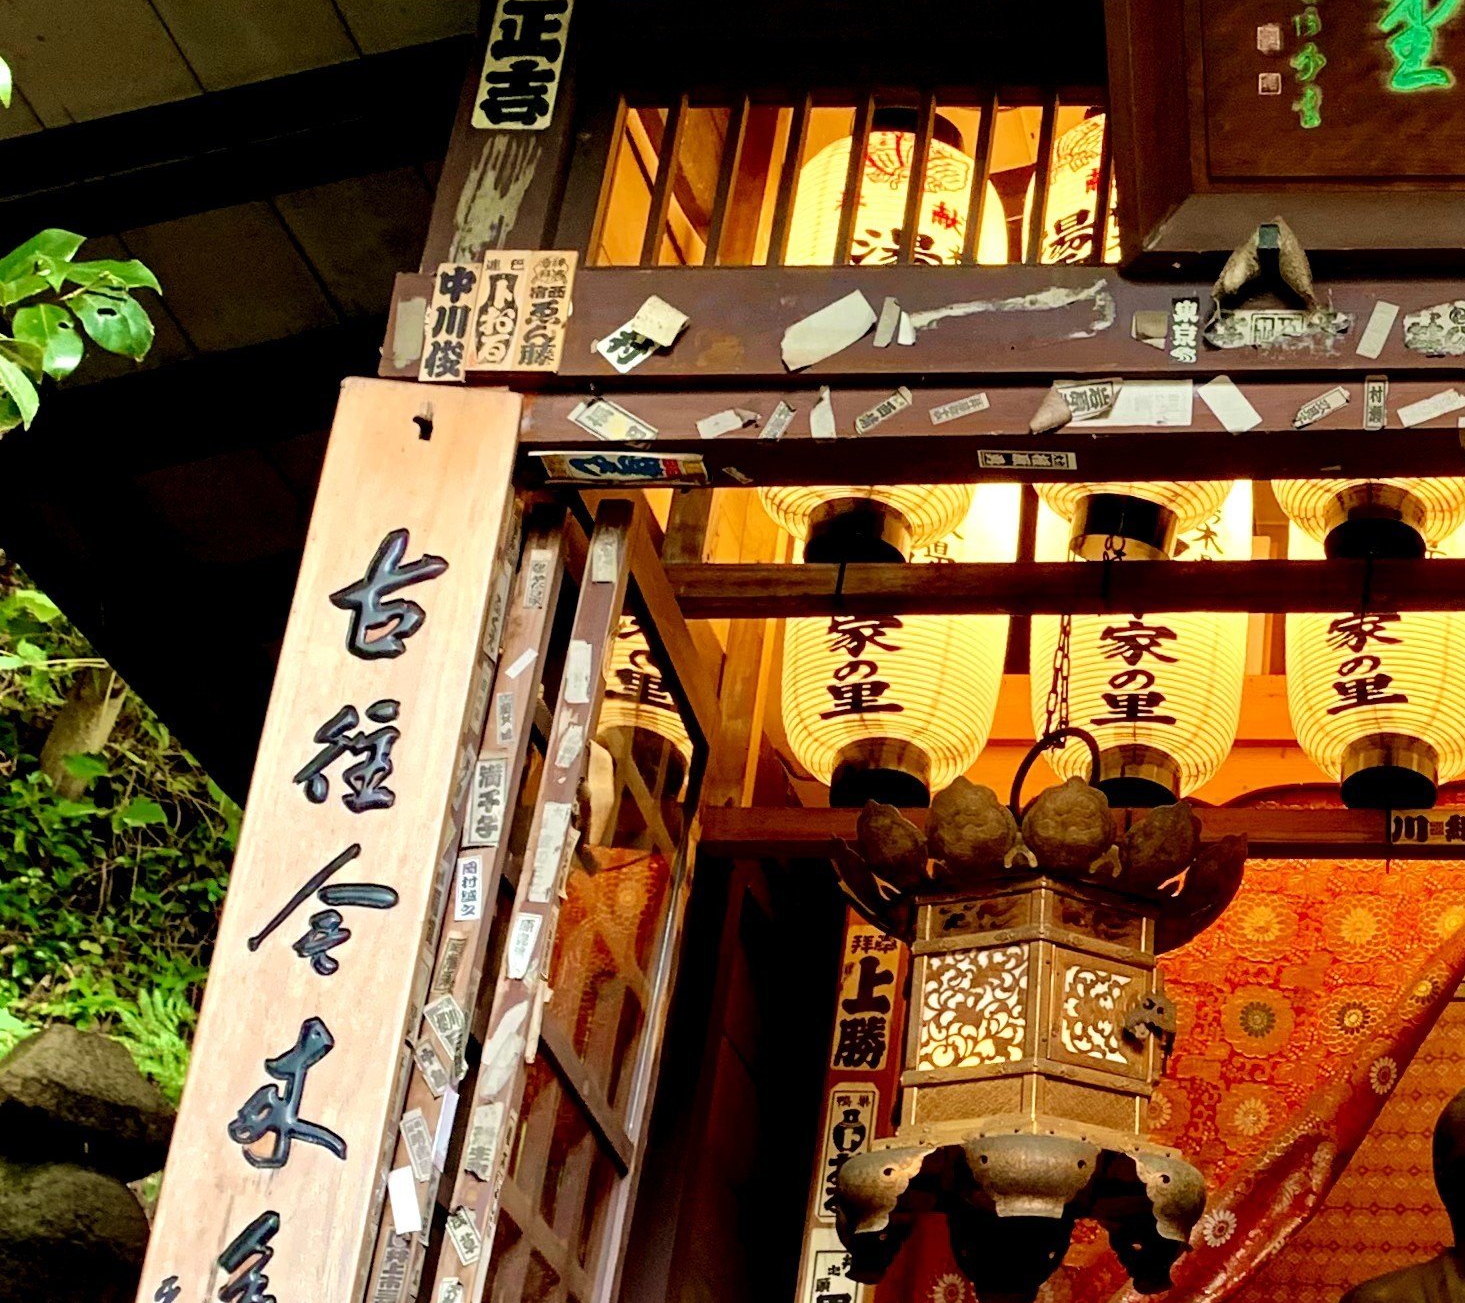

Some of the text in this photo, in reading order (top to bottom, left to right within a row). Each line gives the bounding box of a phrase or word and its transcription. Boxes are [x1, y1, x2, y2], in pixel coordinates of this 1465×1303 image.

[424, 265, 477, 378] 中川俊
[833, 955, 894, 1069] 上勝
